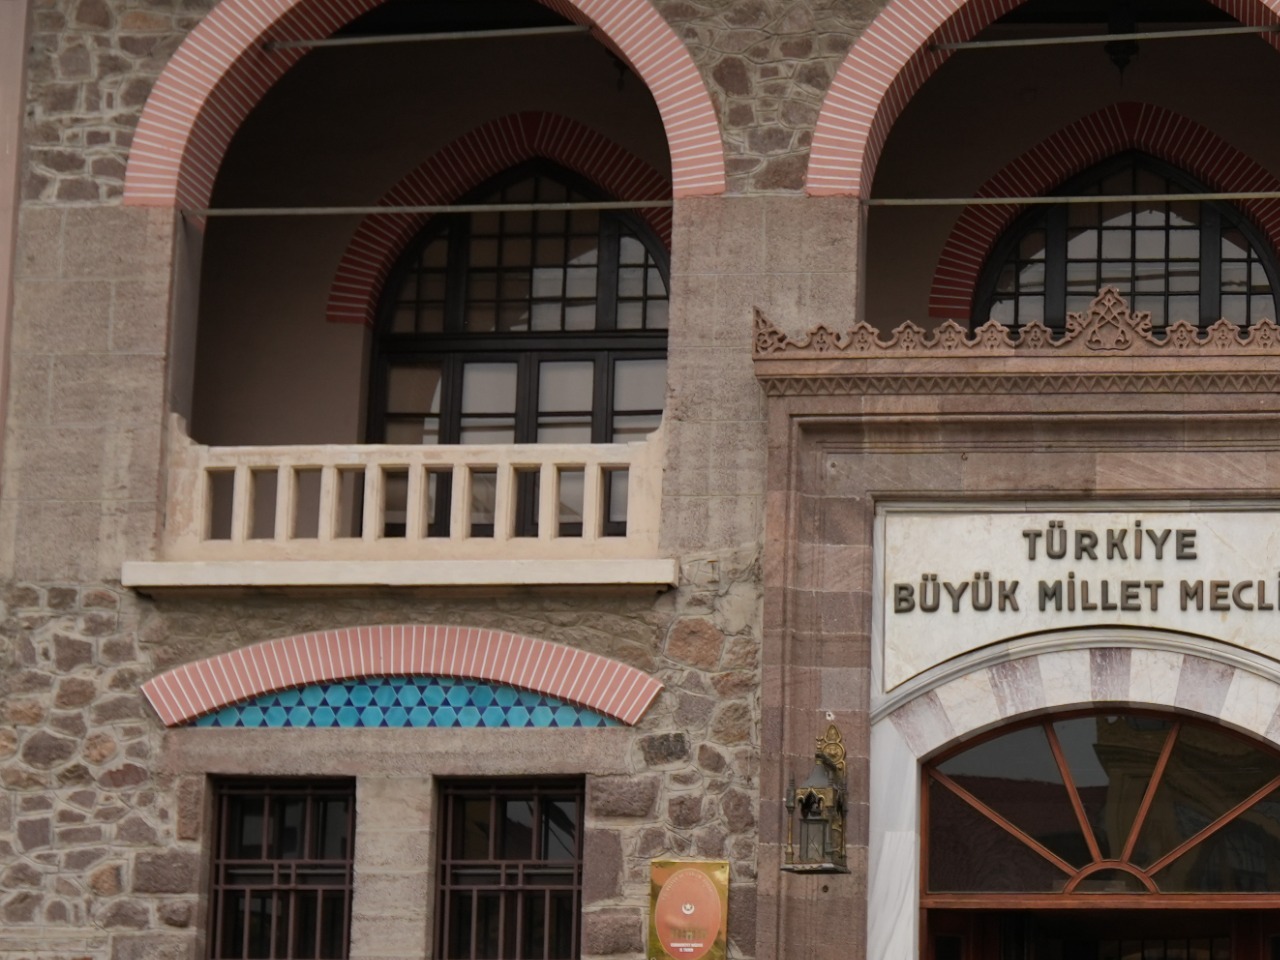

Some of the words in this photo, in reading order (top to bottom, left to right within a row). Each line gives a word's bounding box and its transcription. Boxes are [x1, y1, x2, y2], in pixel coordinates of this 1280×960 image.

[1022, 519, 1198, 561] TÜRKİYE
[893, 571, 1020, 614] BÜYÜK
[1037, 571, 1165, 612] MİLLET
